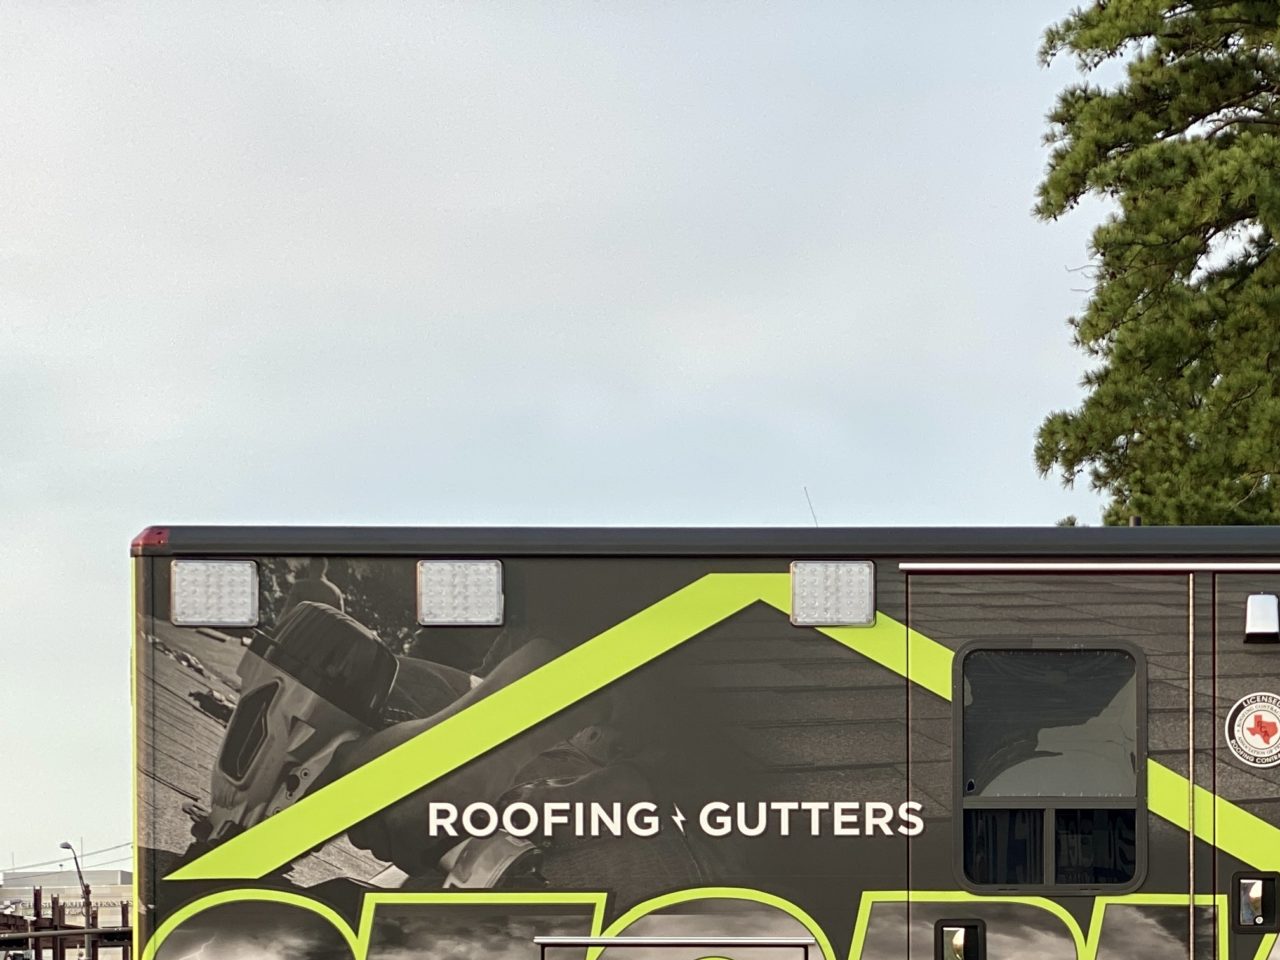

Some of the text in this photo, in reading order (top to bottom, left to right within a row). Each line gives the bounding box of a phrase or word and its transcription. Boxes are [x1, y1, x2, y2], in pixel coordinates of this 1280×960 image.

[1230, 739, 1255, 762] ROOFING
[428, 801, 925, 837] ROOFING GUTTERS
